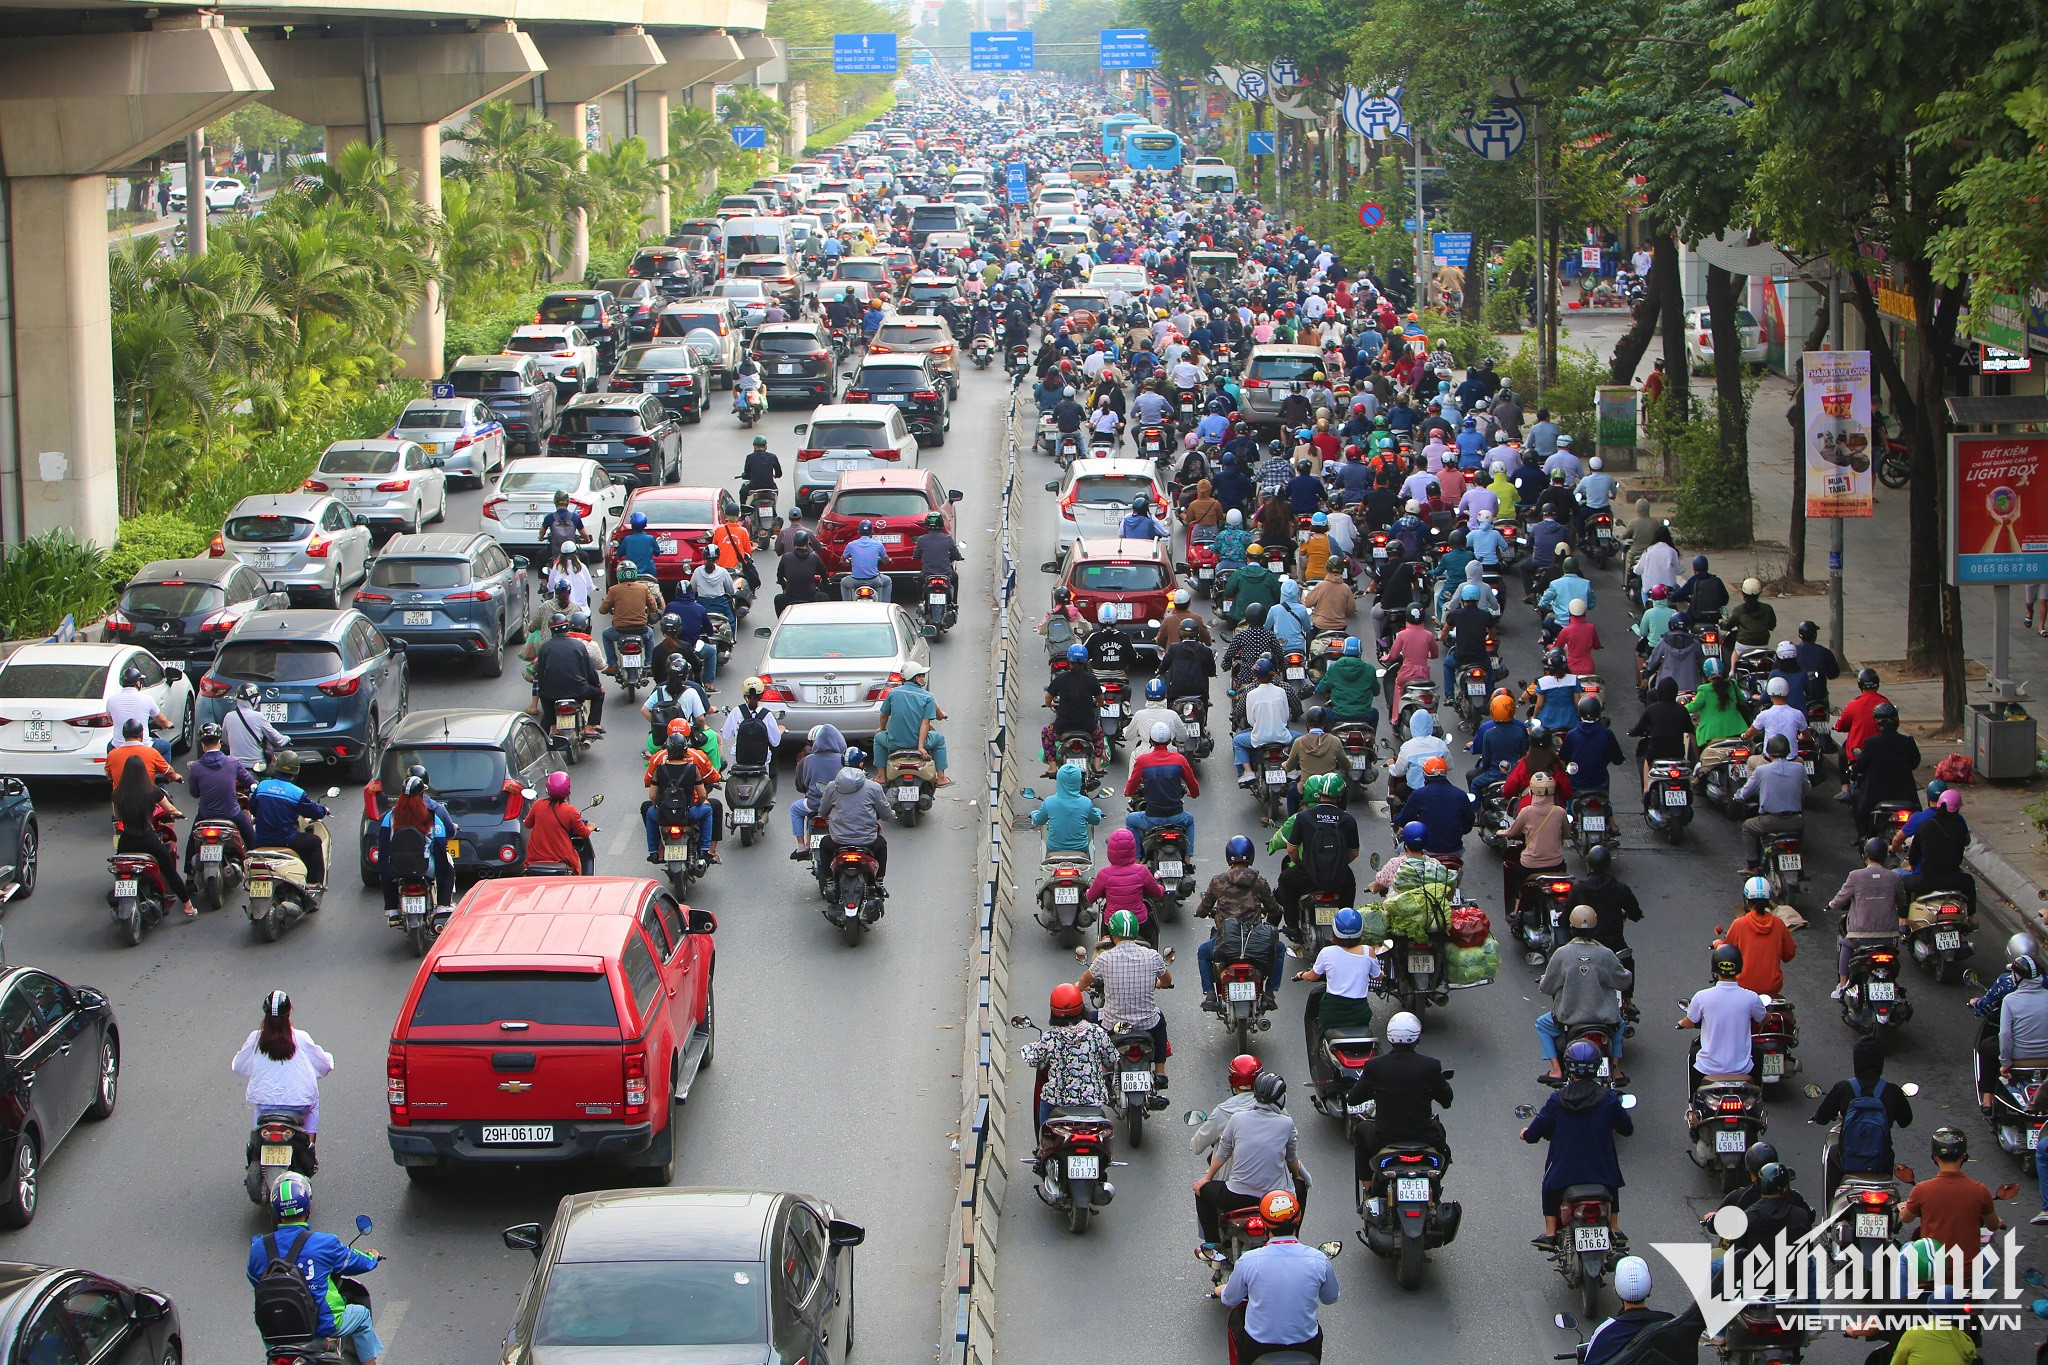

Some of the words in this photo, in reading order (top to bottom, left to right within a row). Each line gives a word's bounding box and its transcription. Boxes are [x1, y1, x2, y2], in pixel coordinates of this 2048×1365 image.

[437, 386, 448, 397] G7
[1982, 447, 2002, 458] TIẾT
[2002, 446, 2029, 460] KIỆM
[1966, 467, 2008, 481] LIGHT
[2008, 464, 2039, 477] BOX
[1971, 564, 1995, 573] 0865
[1998, 564, 2009, 572] 86
[2012, 564, 2023, 572] 87
[2026, 563, 2038, 572] 86
[1100, 641, 1122, 651] CELINE
[819, 694, 843, 703] 124.61
[267, 704, 281, 712] 30E
[264, 713, 287, 722] 76.79
[30, 721, 45, 730] 30E
[25, 731, 51, 740] 405.85
[1124, 1082, 1149, 1090] 008.76
[484, 1127, 552, 1141] 29H-061.07
[1720, 1132, 1741, 1141] 29-G1
[1718, 1142, 1743, 1151] 458.15
[1073, 1158, 1094, 1167] 29-T1
[1071, 1168, 1097, 1177] 881.73
[1402, 1180, 1424, 1189] 59-E1
[1399, 1190, 1428, 1200] 845.86
[1862, 1216, 1883, 1226] 36-B5
[1580, 1228, 1604, 1238] 36-B4
[1858, 1227, 1886, 1236] 692.71
[1578, 1239, 1607, 1249] 016.62
